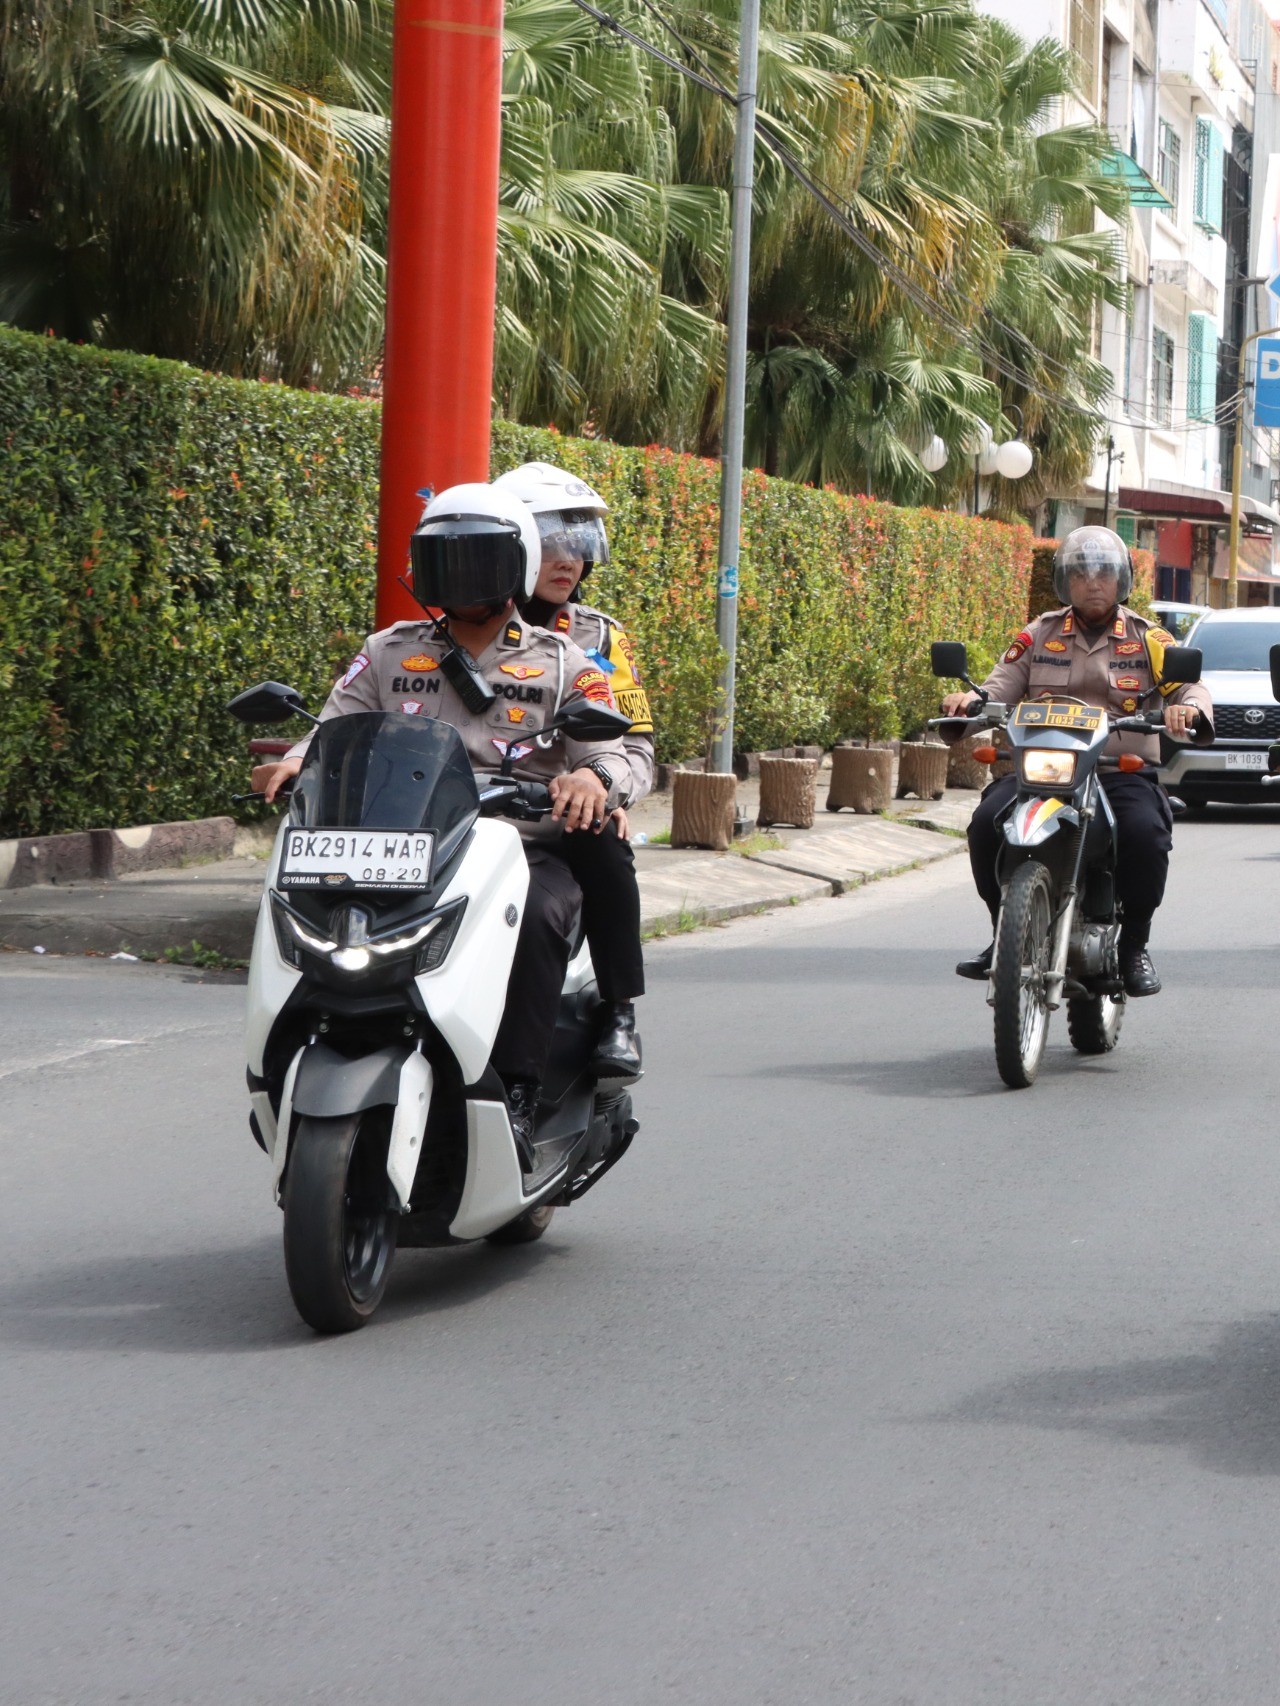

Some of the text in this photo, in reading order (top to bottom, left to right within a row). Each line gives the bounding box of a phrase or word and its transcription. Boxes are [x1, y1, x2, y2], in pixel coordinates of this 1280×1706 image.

[391, 676, 440, 694] ELON
[493, 682, 544, 704] POLRI
[1227, 753, 1238, 764] BK
[1241, 754, 1262, 764] 1039
[383, 838, 427, 860] WAR
[290, 876, 321, 884] YAMAHA
